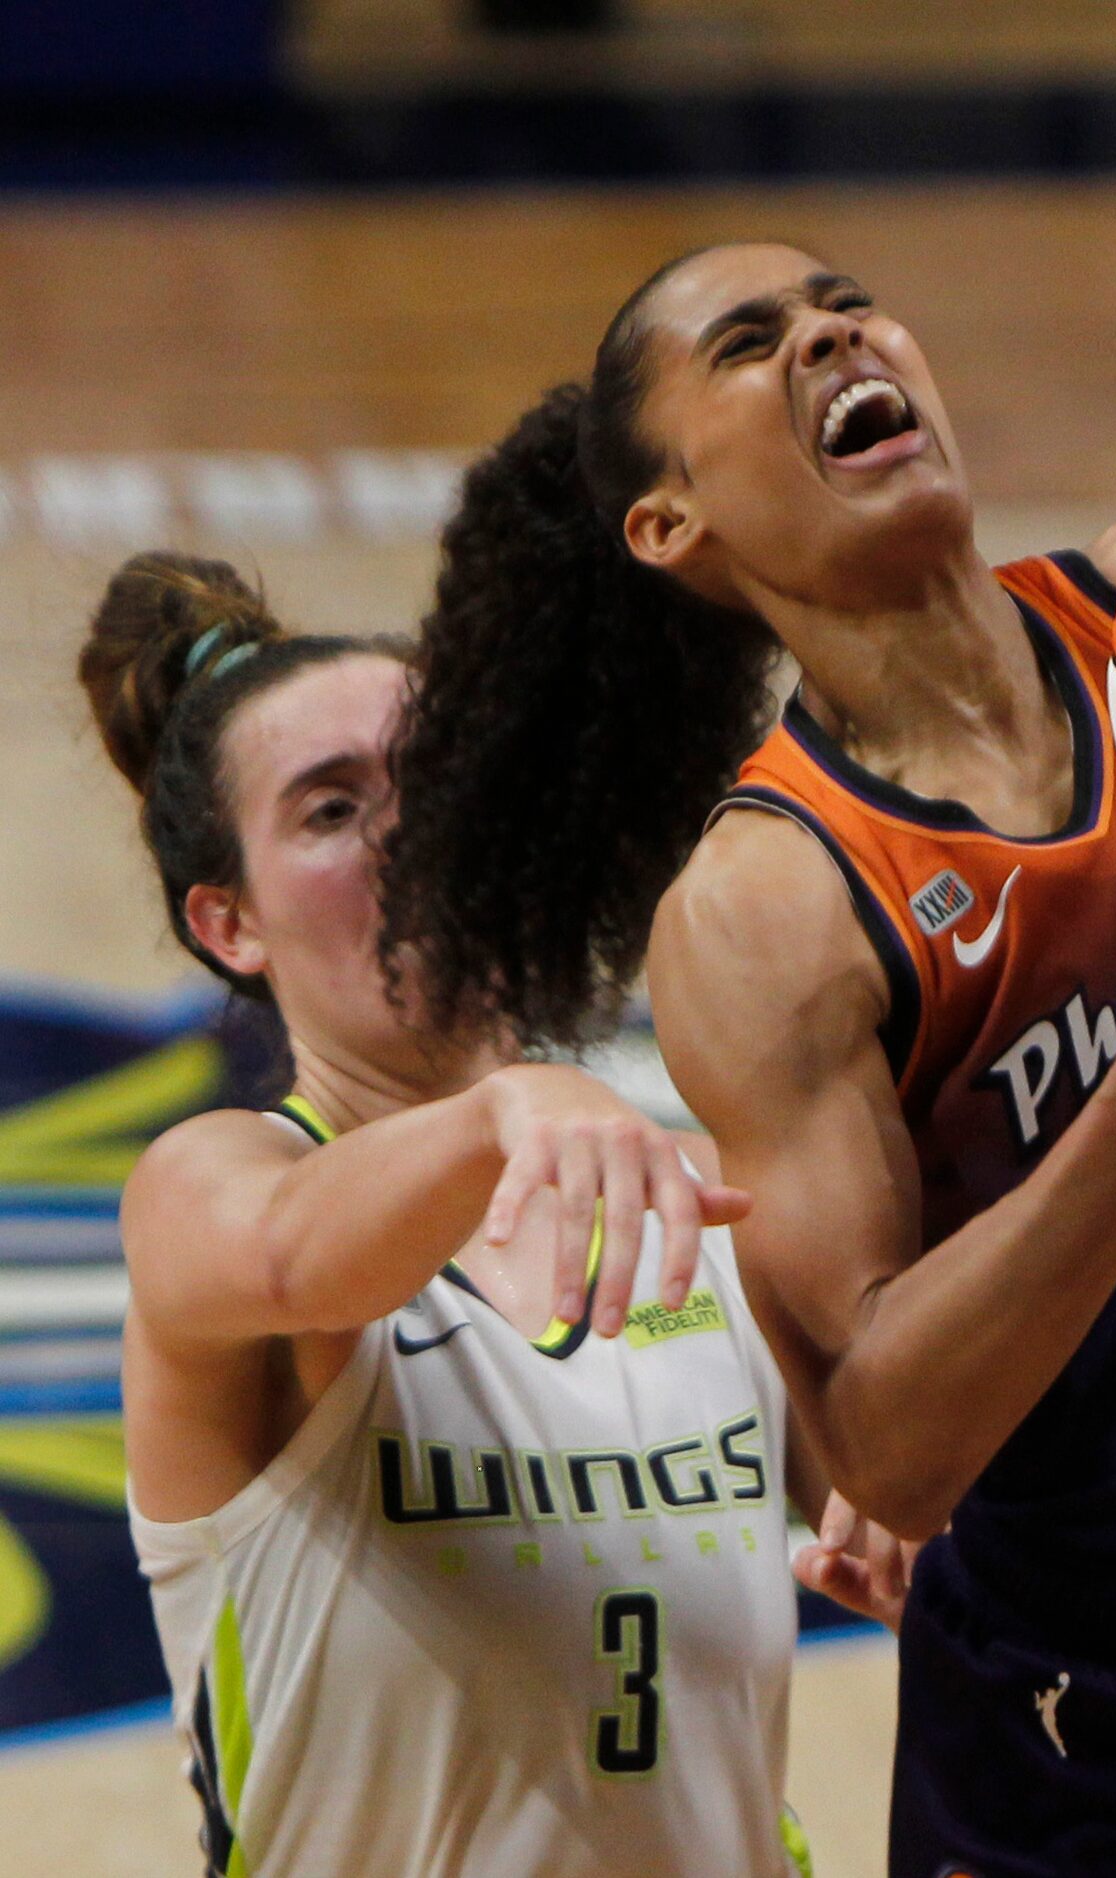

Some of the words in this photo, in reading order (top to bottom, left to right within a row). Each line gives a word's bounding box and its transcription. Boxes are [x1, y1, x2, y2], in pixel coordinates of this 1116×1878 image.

[626, 1291, 717, 1328] AMECAN
[645, 1308, 720, 1337] FIDELITY
[374, 1410, 768, 1526] WINGS
[594, 1587, 665, 1777] 3
